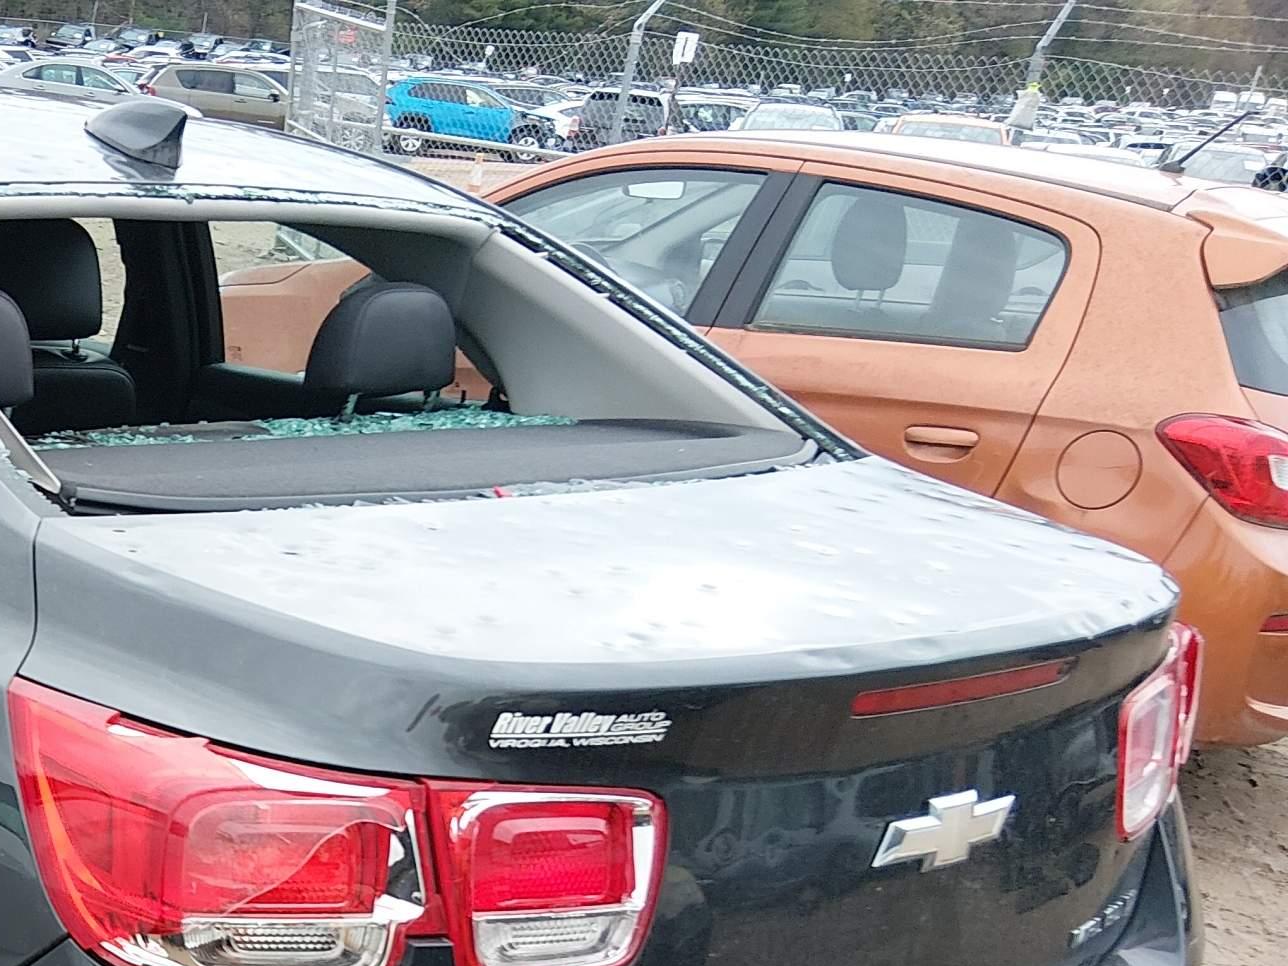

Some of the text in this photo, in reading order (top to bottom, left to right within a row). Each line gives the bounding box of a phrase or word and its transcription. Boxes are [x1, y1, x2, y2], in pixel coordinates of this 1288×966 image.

[491, 711, 617, 734] River Valley
[614, 711, 667, 723] AUTO
[610, 720, 673, 732] GROUP
[572, 734, 665, 747] WISCONSIN
